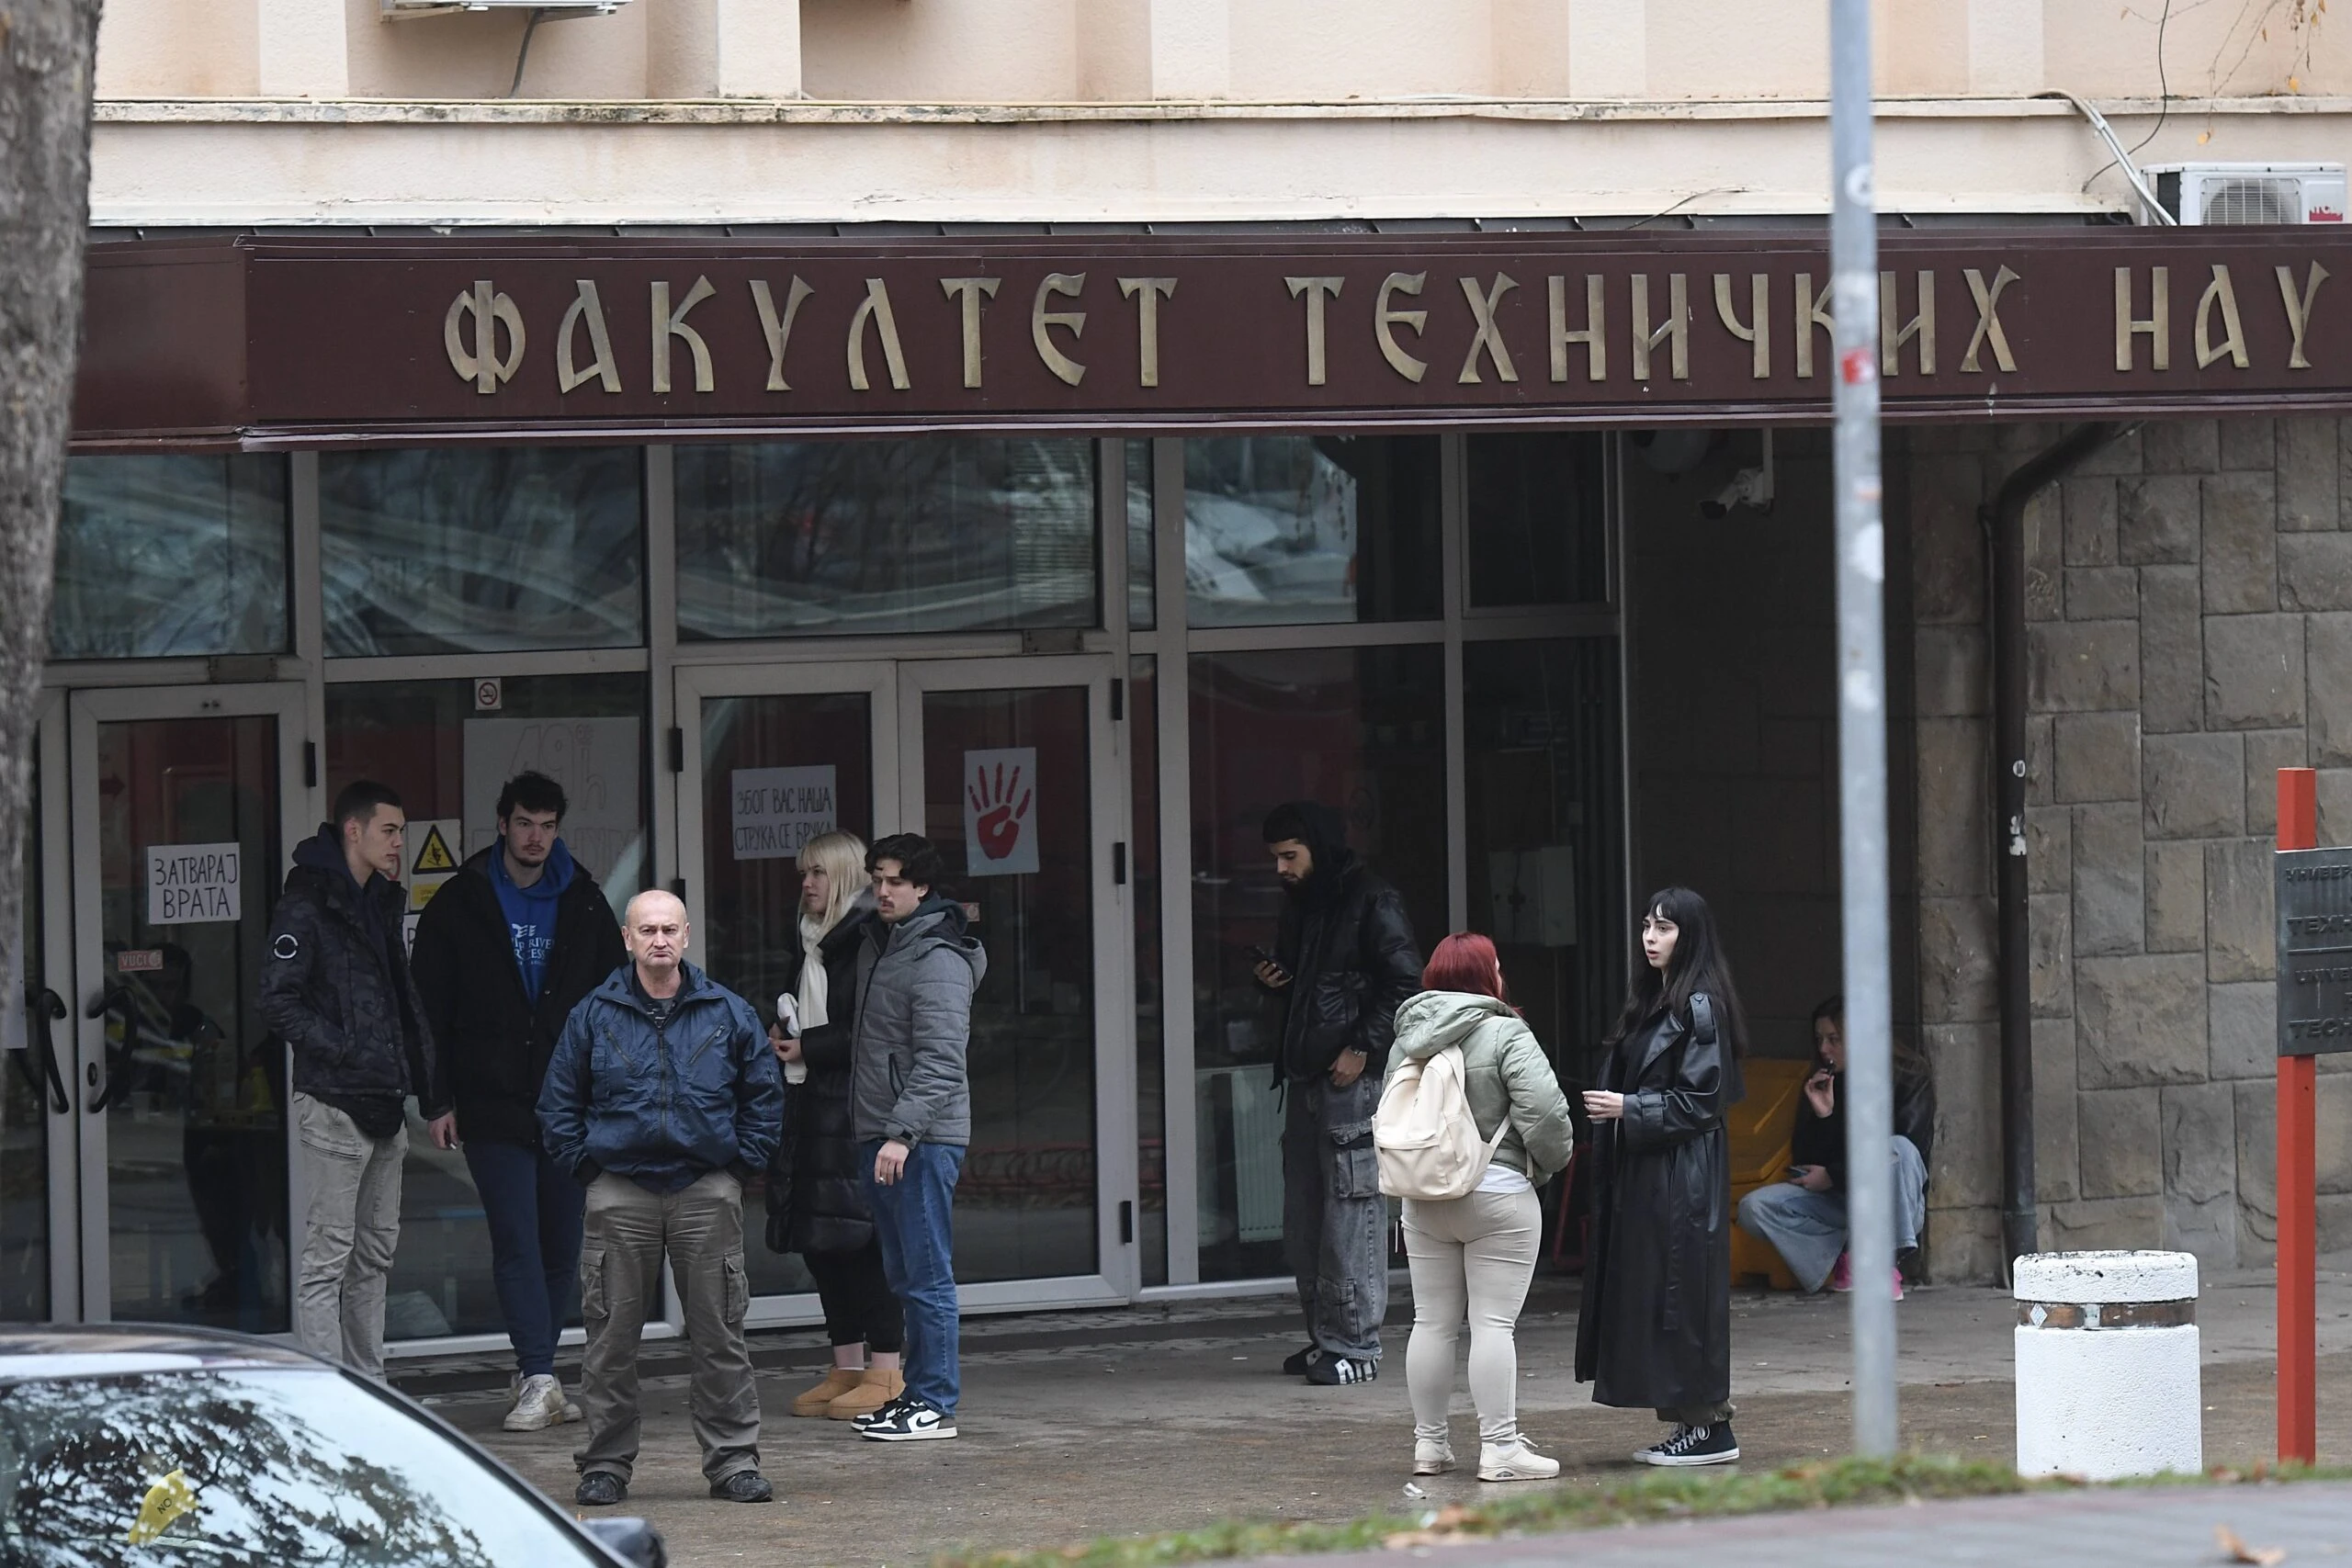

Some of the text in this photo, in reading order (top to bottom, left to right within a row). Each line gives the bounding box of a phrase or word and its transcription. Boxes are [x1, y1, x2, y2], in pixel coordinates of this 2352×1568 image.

[445, 260, 2331, 394] ФАКУЛТЕТ ТЕХНИЧКИХ НАУ
[737, 786, 832, 816] ЗБОГ ВАС НАША
[735, 825, 777, 852] СТРУКА
[778, 823, 792, 850] СЕ
[154, 853, 238, 886] ЗАТВАРАЈ
[2286, 865, 2352, 883] УНИВЕР
[163, 887, 232, 919] ВРАТА
[2295, 969, 2352, 986] UNIVE
